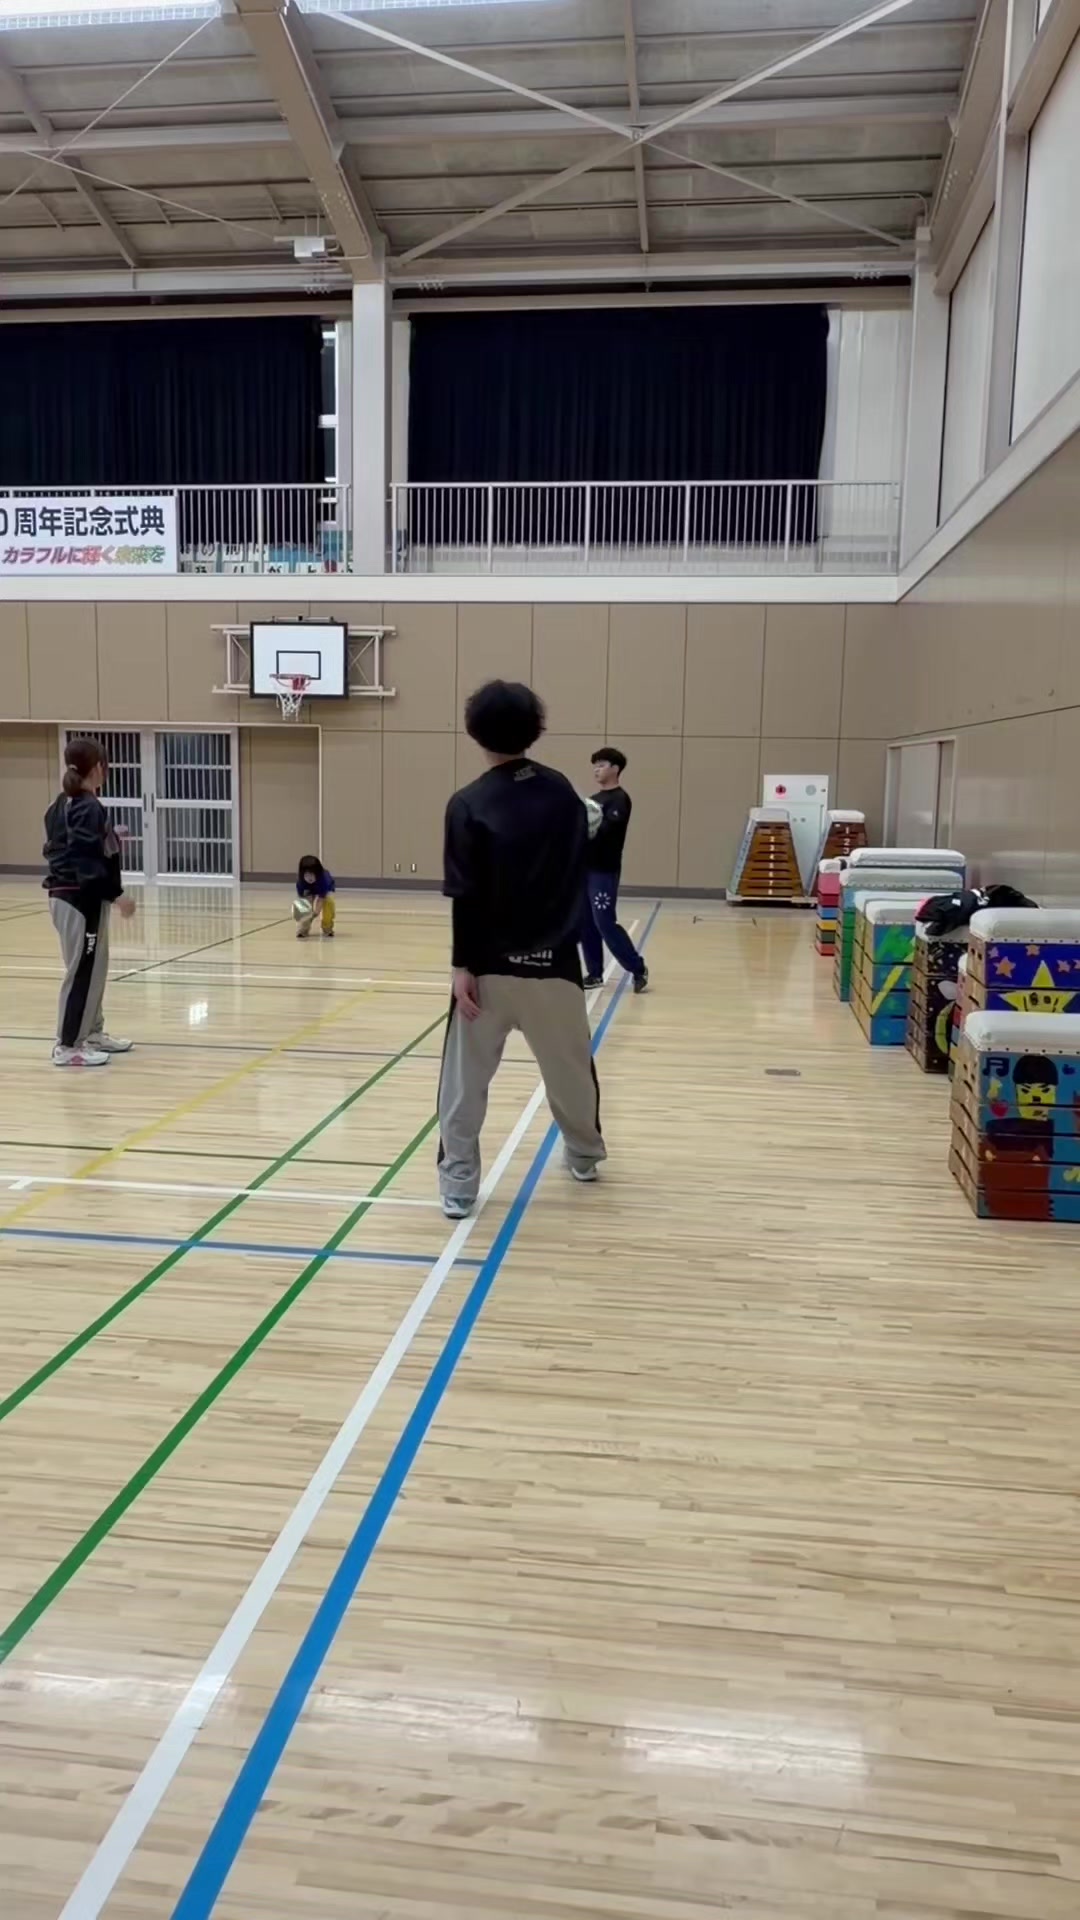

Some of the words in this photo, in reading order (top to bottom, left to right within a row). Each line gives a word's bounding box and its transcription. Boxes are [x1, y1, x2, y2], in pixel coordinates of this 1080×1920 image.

[2, 545, 166, 565] カラフルに輝く未来を
